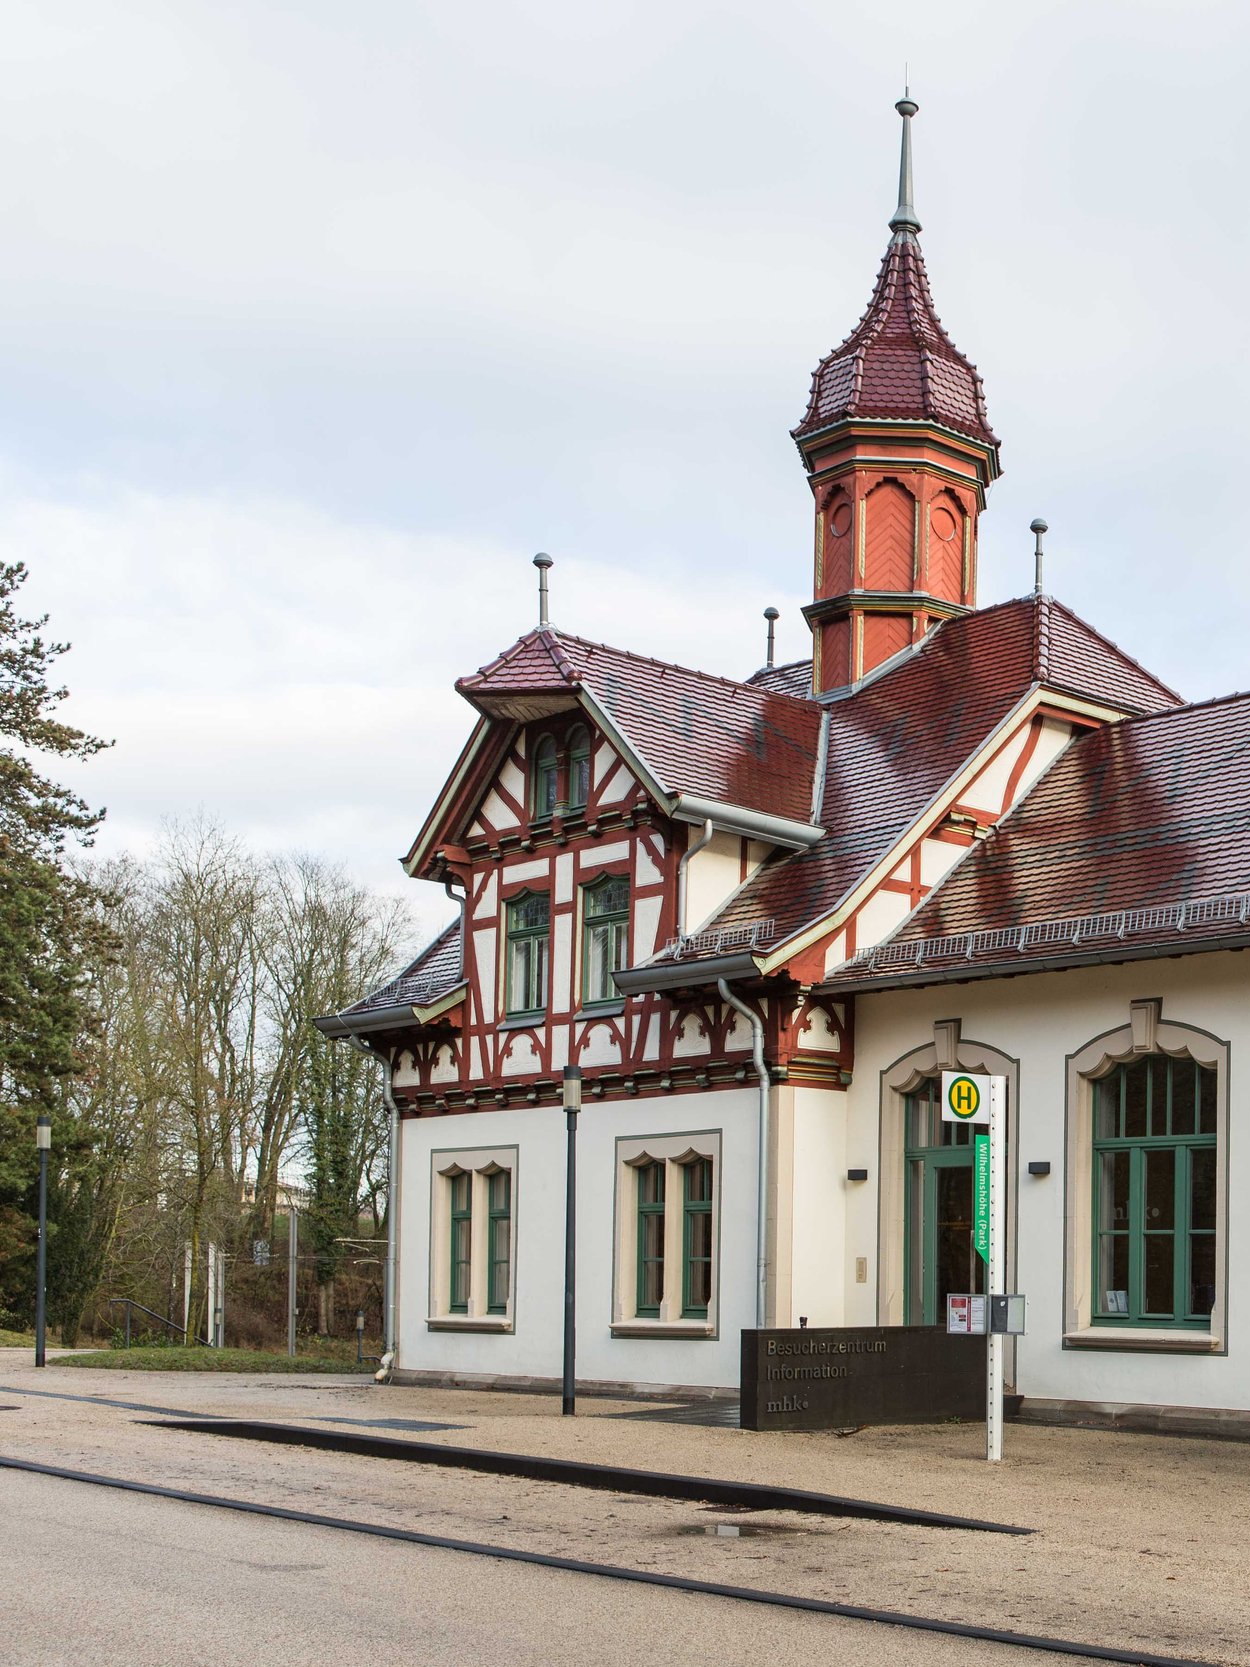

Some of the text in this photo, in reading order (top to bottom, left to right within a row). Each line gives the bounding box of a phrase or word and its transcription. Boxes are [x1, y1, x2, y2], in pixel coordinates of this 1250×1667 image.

[957, 1085, 971, 1110] H
[978, 1143, 988, 1250] Wilhelmshöhe (Park)
[767, 1339, 886, 1355] Besucherzentrum
[767, 1363, 847, 1380] Information
